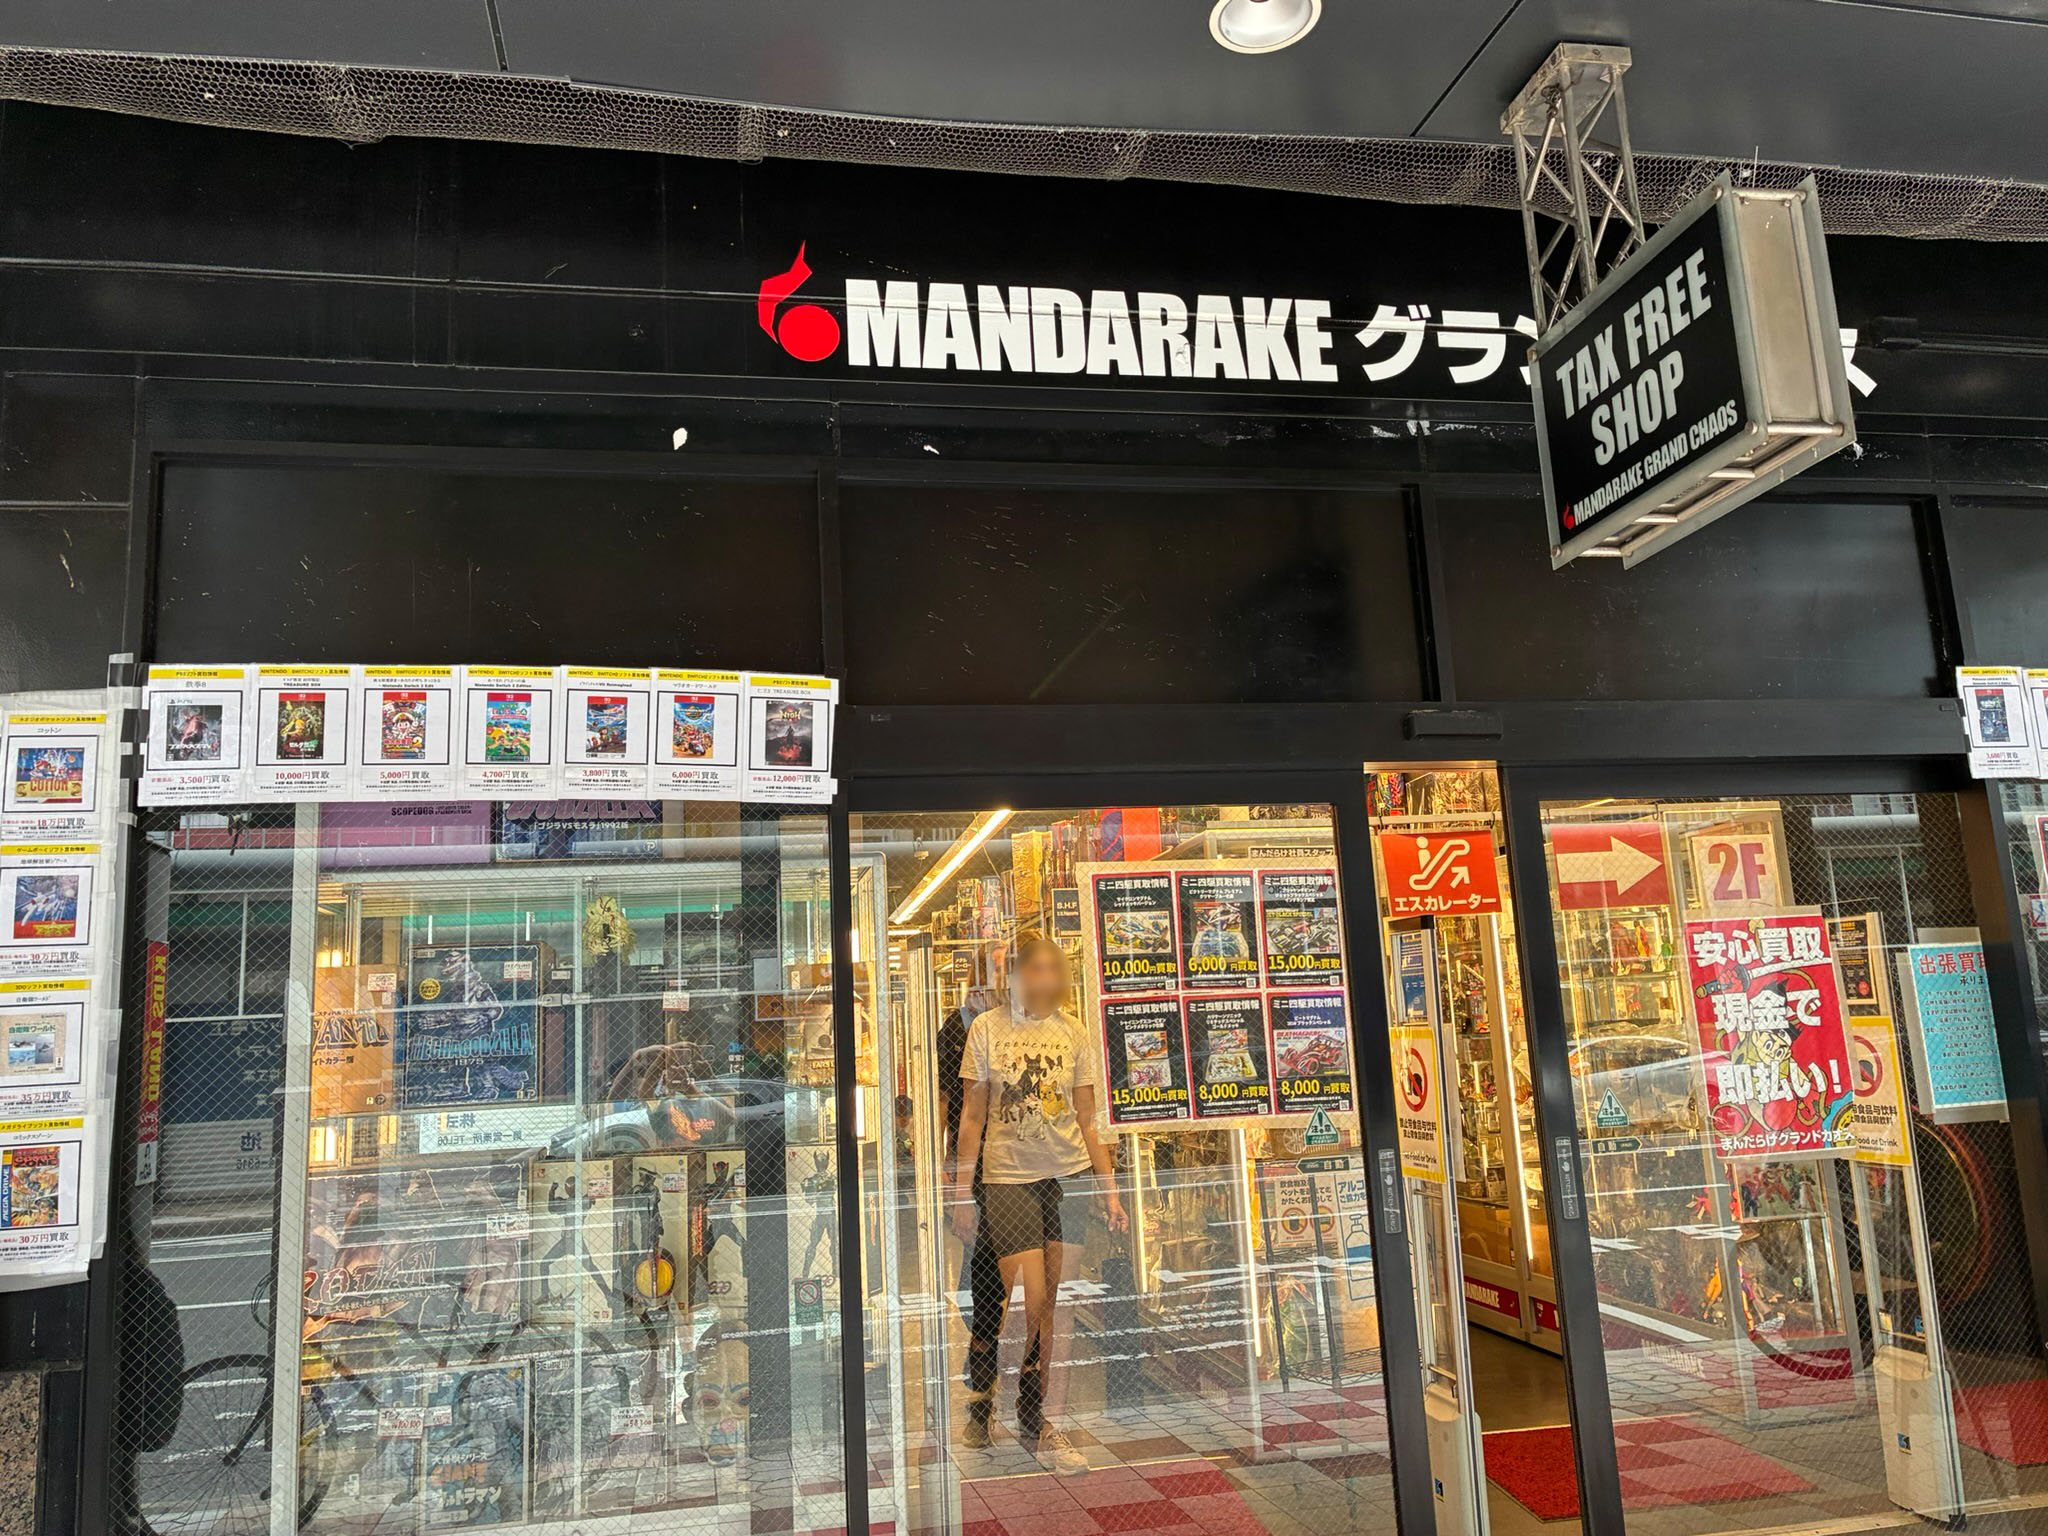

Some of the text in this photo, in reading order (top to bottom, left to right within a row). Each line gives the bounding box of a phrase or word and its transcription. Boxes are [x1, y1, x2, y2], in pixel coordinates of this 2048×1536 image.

[845, 279, 1338, 382] MANDARAKE
[1556, 248, 1712, 420] TAX FREE
[1591, 349, 1685, 466] SHOP
[1573, 400, 1738, 526] MANDARAKE GRAND CHAOS
[275, 771, 330, 780] 10,000円買取
[380, 771, 429, 779] 5,000円買取
[482, 770, 529, 779] 4,700円買取
[582, 769, 628, 778] 3,800円買取
[672, 770, 719, 780] 6,000円買取
[773, 774, 821, 784] 12,000円買取
[179, 775, 231, 784] 3,500円買取
[37, 818, 86, 827] 18万円買取
[1708, 841, 1766, 901] 2F
[1394, 894, 1497, 913] エスカレーター
[1692, 925, 1827, 967] 安心買取
[29, 951, 80, 961] 30万円買取
[1711, 988, 1822, 1033] 現金で
[1717, 1058, 1841, 1105] 即払い!
[20, 1090, 72, 1101] 35万円買取
[1720, 1128, 1856, 1150] まんだらけグランドカオス
[1280, 1180, 1307, 1188] 飲食物及
[19, 1232, 69, 1244] 30万円買取
